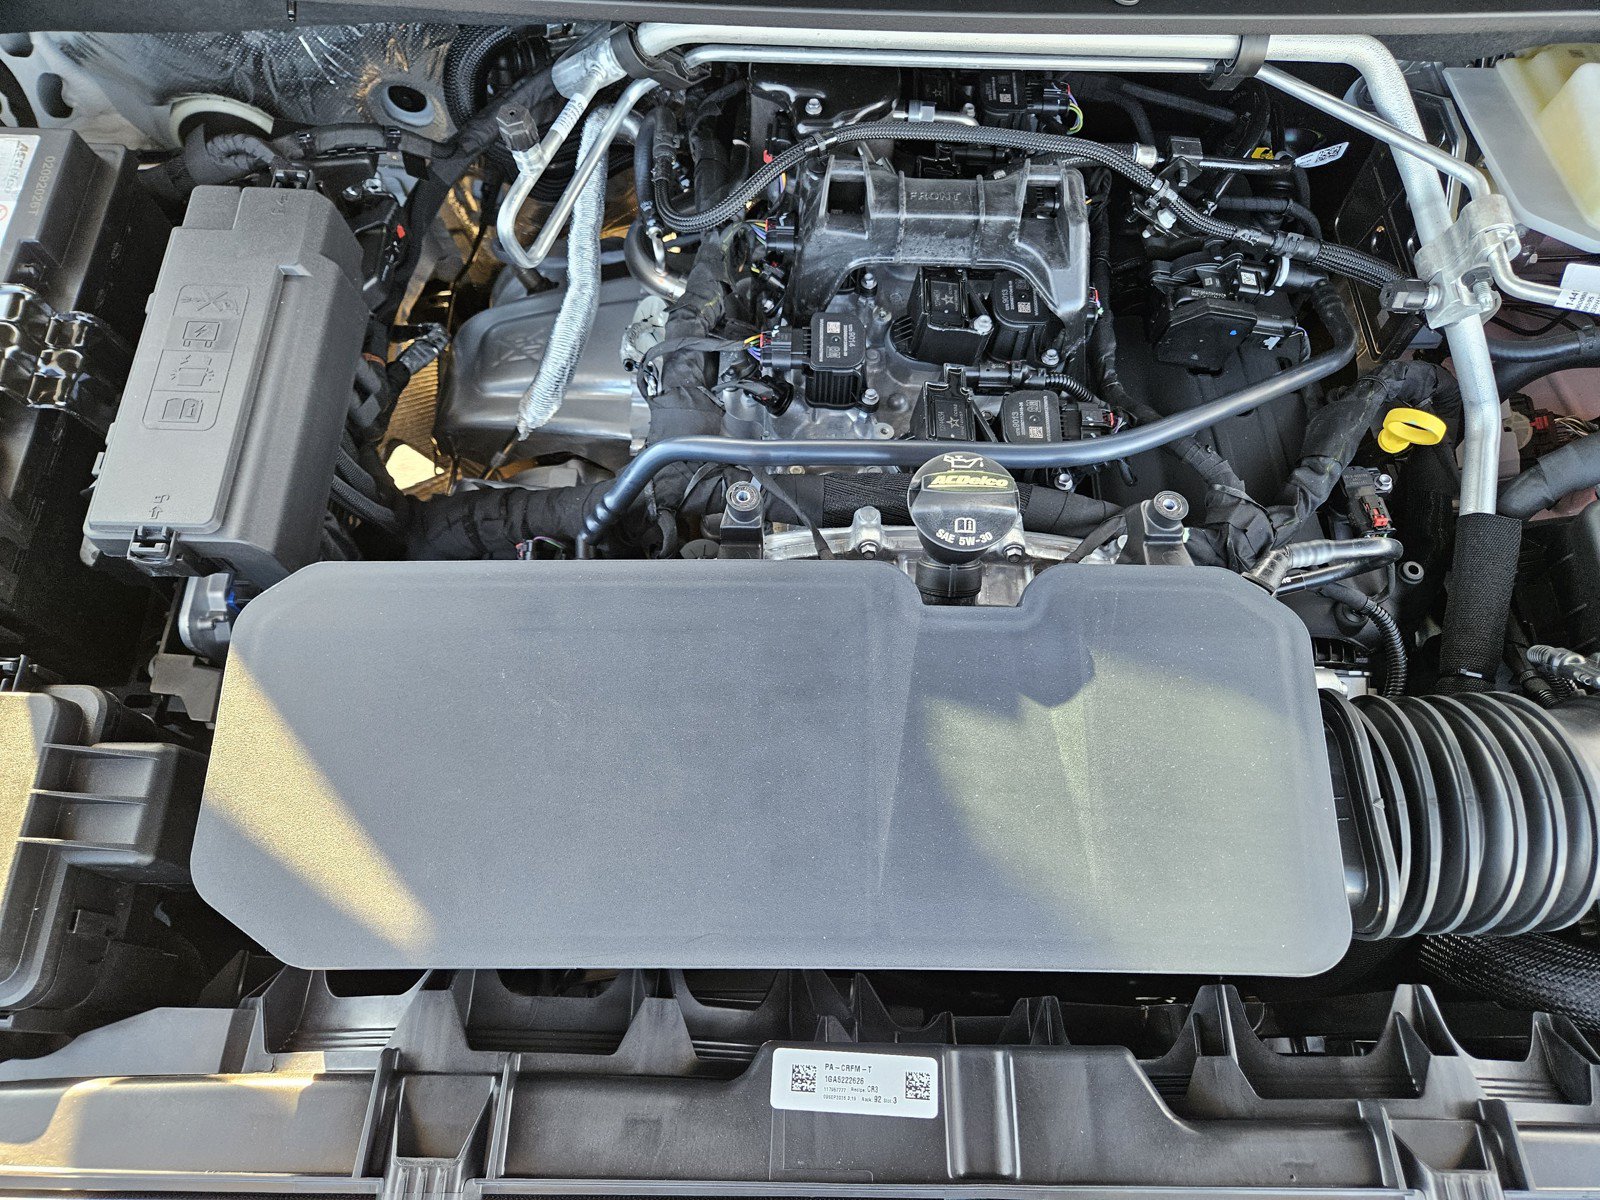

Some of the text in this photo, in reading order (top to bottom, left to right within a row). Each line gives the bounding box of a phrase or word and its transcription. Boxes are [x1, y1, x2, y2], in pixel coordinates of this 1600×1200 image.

[910, 191, 962, 201] FRONT
[928, 474, 1009, 488] ACDelco
[936, 529, 993, 546] SAE 5W-30
[866, 1085, 879, 1094] CR3
[873, 1095, 882, 1104] 92
[892, 1096, 898, 1105] 3
